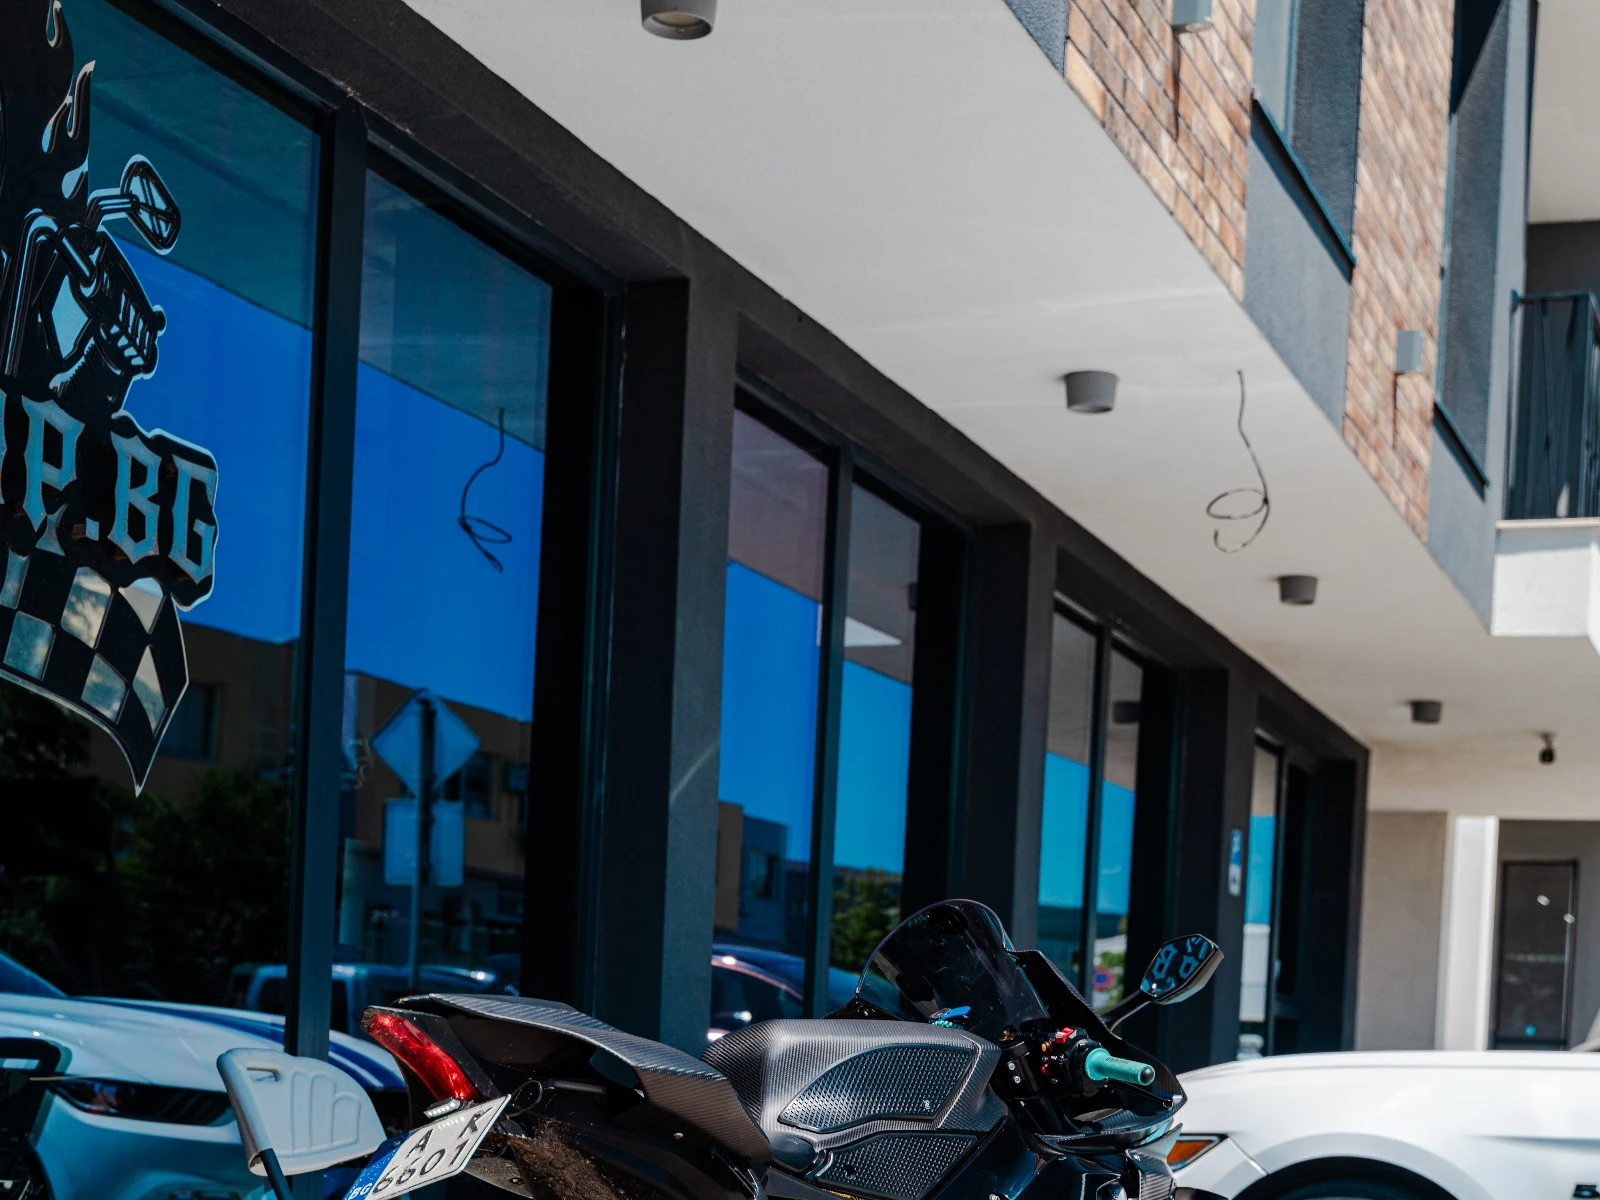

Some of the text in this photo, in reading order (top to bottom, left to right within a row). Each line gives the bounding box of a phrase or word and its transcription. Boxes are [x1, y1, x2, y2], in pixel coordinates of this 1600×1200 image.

[0, 389, 217, 585] P.BG
[405, 1106, 496, 1159] A K
[348, 1182, 373, 1200] BG
[371, 1138, 471, 1195] 6601
